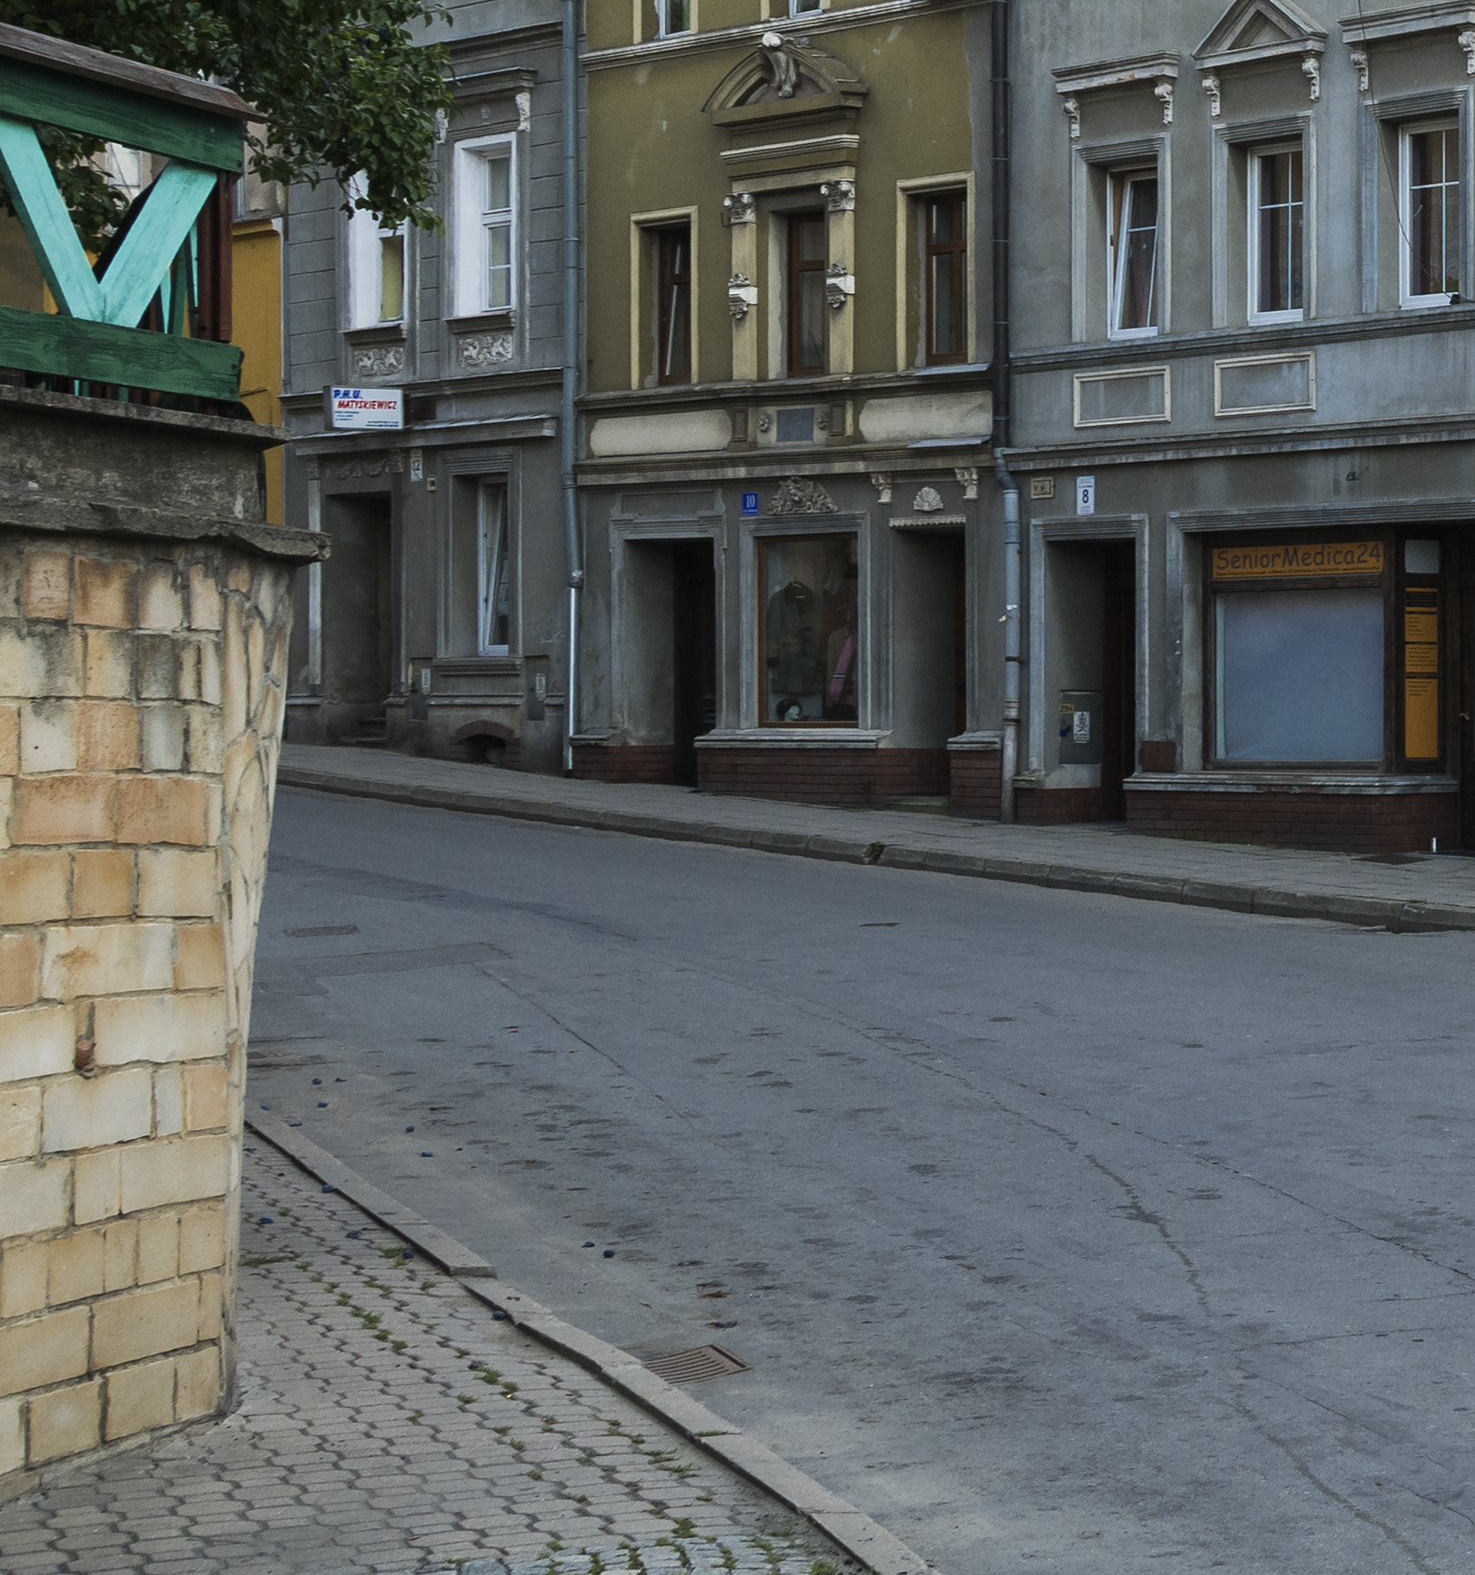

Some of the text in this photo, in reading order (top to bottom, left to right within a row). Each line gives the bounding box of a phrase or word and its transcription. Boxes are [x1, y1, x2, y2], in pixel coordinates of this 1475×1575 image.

[333, 389, 363, 399] P.H.U.
[337, 400, 397, 410] MATYSKIEWICZ
[411, 459, 421, 471] 12
[746, 494, 756, 508] 10
[1081, 489, 1090, 504] 8
[1215, 542, 1381, 570] SeniorMedica24
